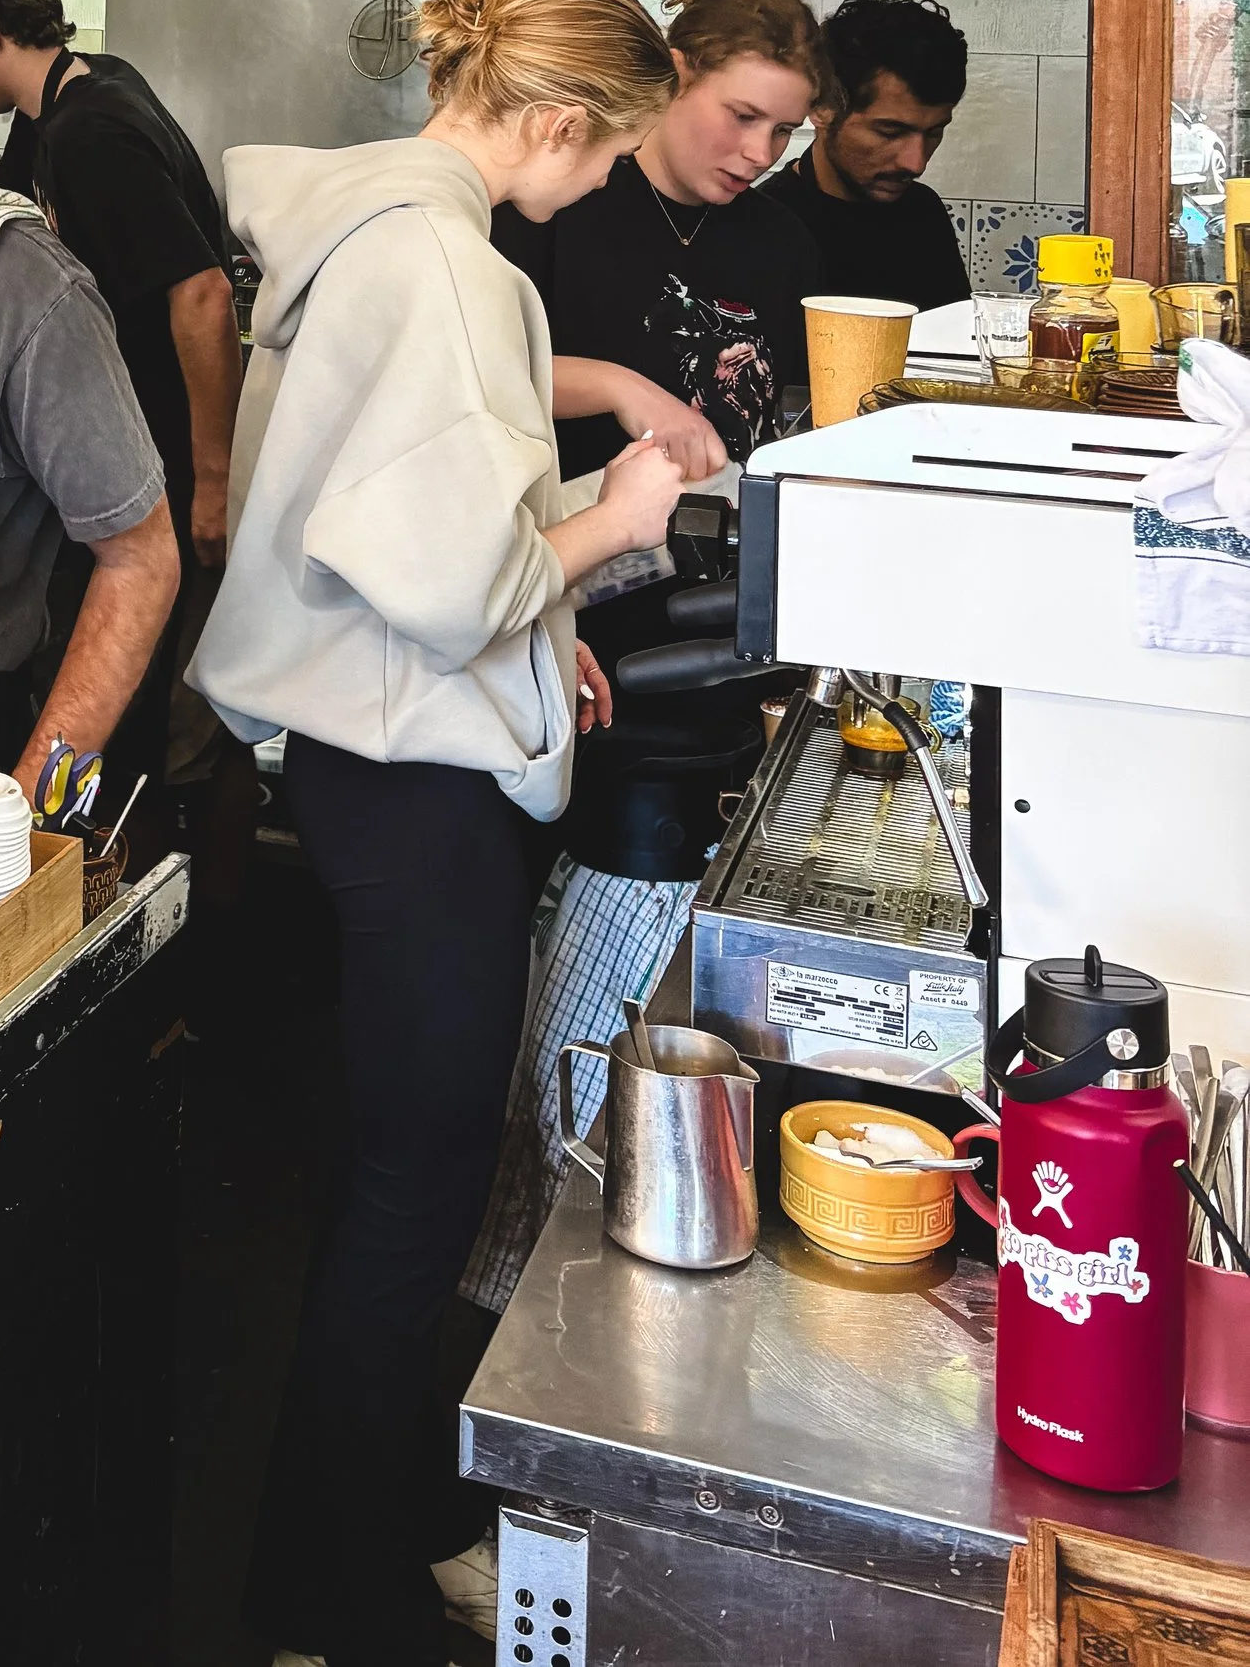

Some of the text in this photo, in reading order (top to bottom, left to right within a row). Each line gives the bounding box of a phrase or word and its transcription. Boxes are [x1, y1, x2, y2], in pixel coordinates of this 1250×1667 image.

[796, 971, 803, 979] la
[804, 973, 838, 985] marzocco
[919, 972, 956, 983] PROPERTY
[920, 995, 940, 1003] Asset
[1024, 1242, 1073, 1277] piss
[1077, 1259, 1133, 1287] girl
[1017, 1405, 1084, 1443] Hydro Flask
